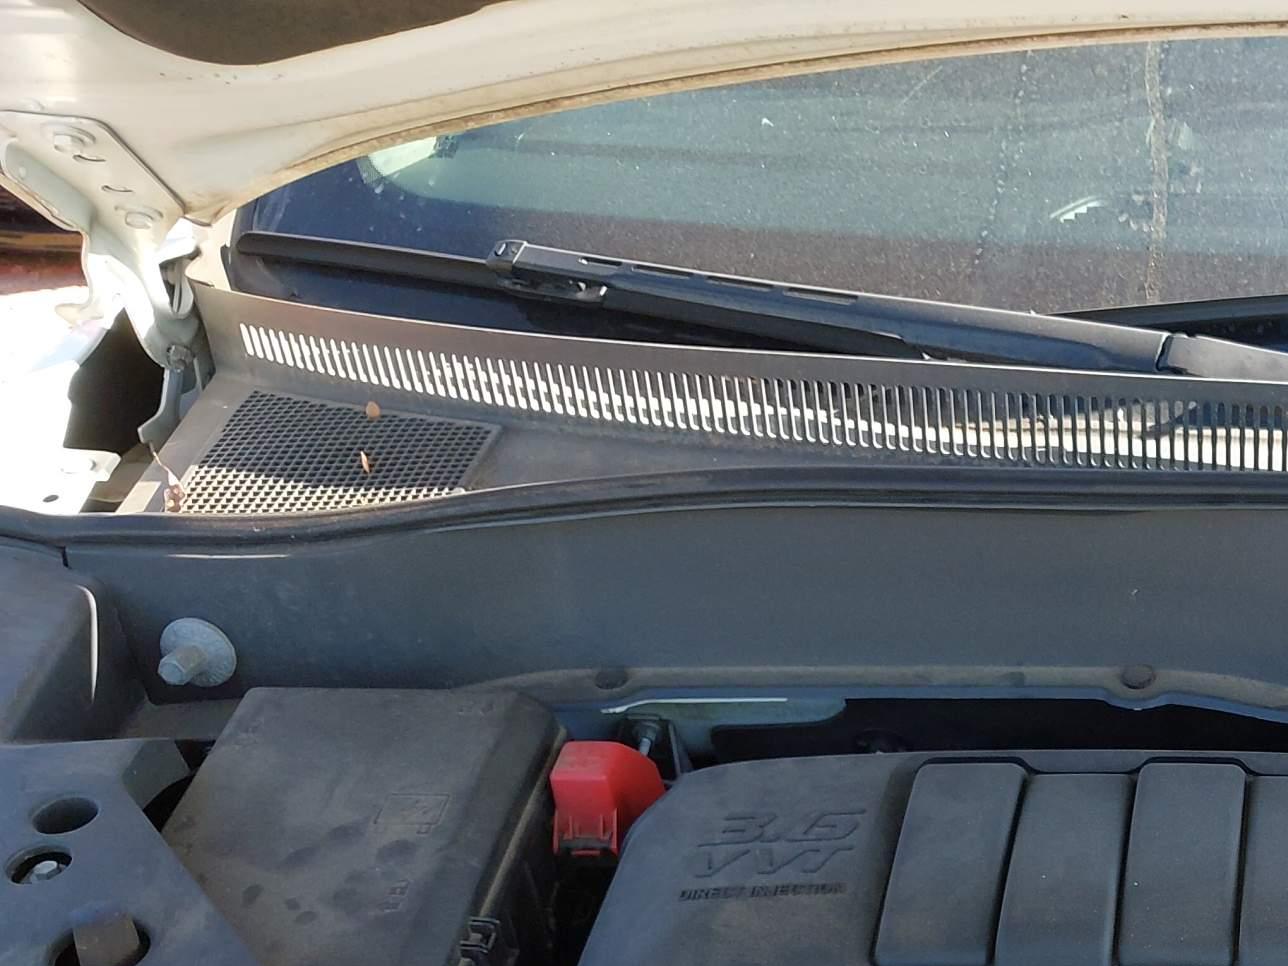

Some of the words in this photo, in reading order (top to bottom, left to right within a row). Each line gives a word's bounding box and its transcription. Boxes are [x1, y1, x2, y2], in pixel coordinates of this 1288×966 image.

[697, 808, 867, 848] 3.6
[690, 846, 855, 878] VVT
[679, 884, 746, 902] DIRECT
[749, 881, 848, 898] INJECTION
